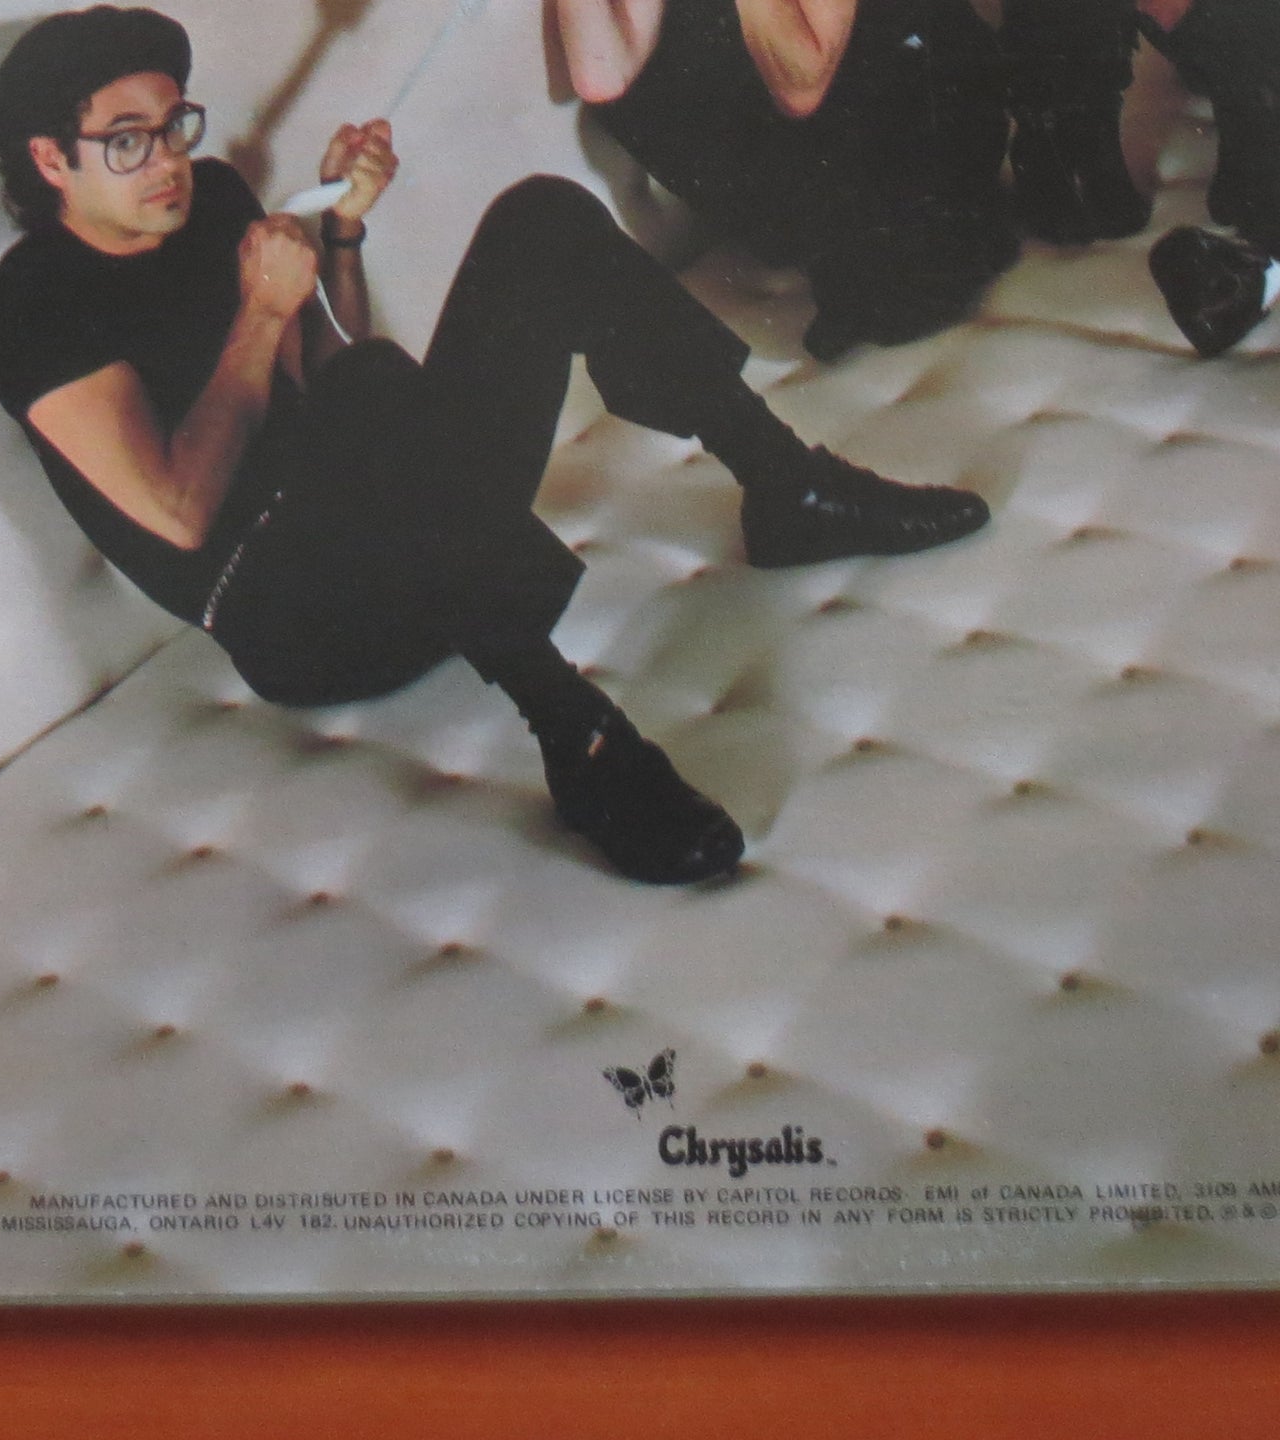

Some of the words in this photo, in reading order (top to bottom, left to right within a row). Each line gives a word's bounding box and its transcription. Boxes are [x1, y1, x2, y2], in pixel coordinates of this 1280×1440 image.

[658, 1124, 824, 1178] Chrysalis
[30, 1193, 197, 1210] MANUFACTURED
[205, 1193, 247, 1209] AND
[256, 1191, 386, 1209] DISTRIBUTED
[395, 1191, 416, 1207] IN
[423, 1190, 507, 1208] CANADA
[515, 1189, 584, 1206] UNDER
[593, 1188, 674, 1205] LICENSE
[683, 1188, 708, 1204] BY
[717, 1187, 800, 1204] CAPITOL
[925, 1186, 958, 1201] EMI
[971, 1186, 989, 1201] of
[1000, 1184, 1083, 1201] CANADA
[150, 1215, 239, 1231] ONTARIO
[251, 1213, 286, 1229] L4V
[344, 1213, 504, 1230] UNAUTHORIZED
[515, 1210, 601, 1228] COPYING
[614, 1210, 638, 1226] OF
[651, 1210, 695, 1226] THIS
[708, 1209, 789, 1226] RECORD
[802, 1209, 821, 1225] IN
[834, 1208, 874, 1224] ANY
[888, 1207, 944, 1223] FORM
[957, 1207, 973, 1223] IS
[984, 1206, 1078, 1223] STRICTLY
